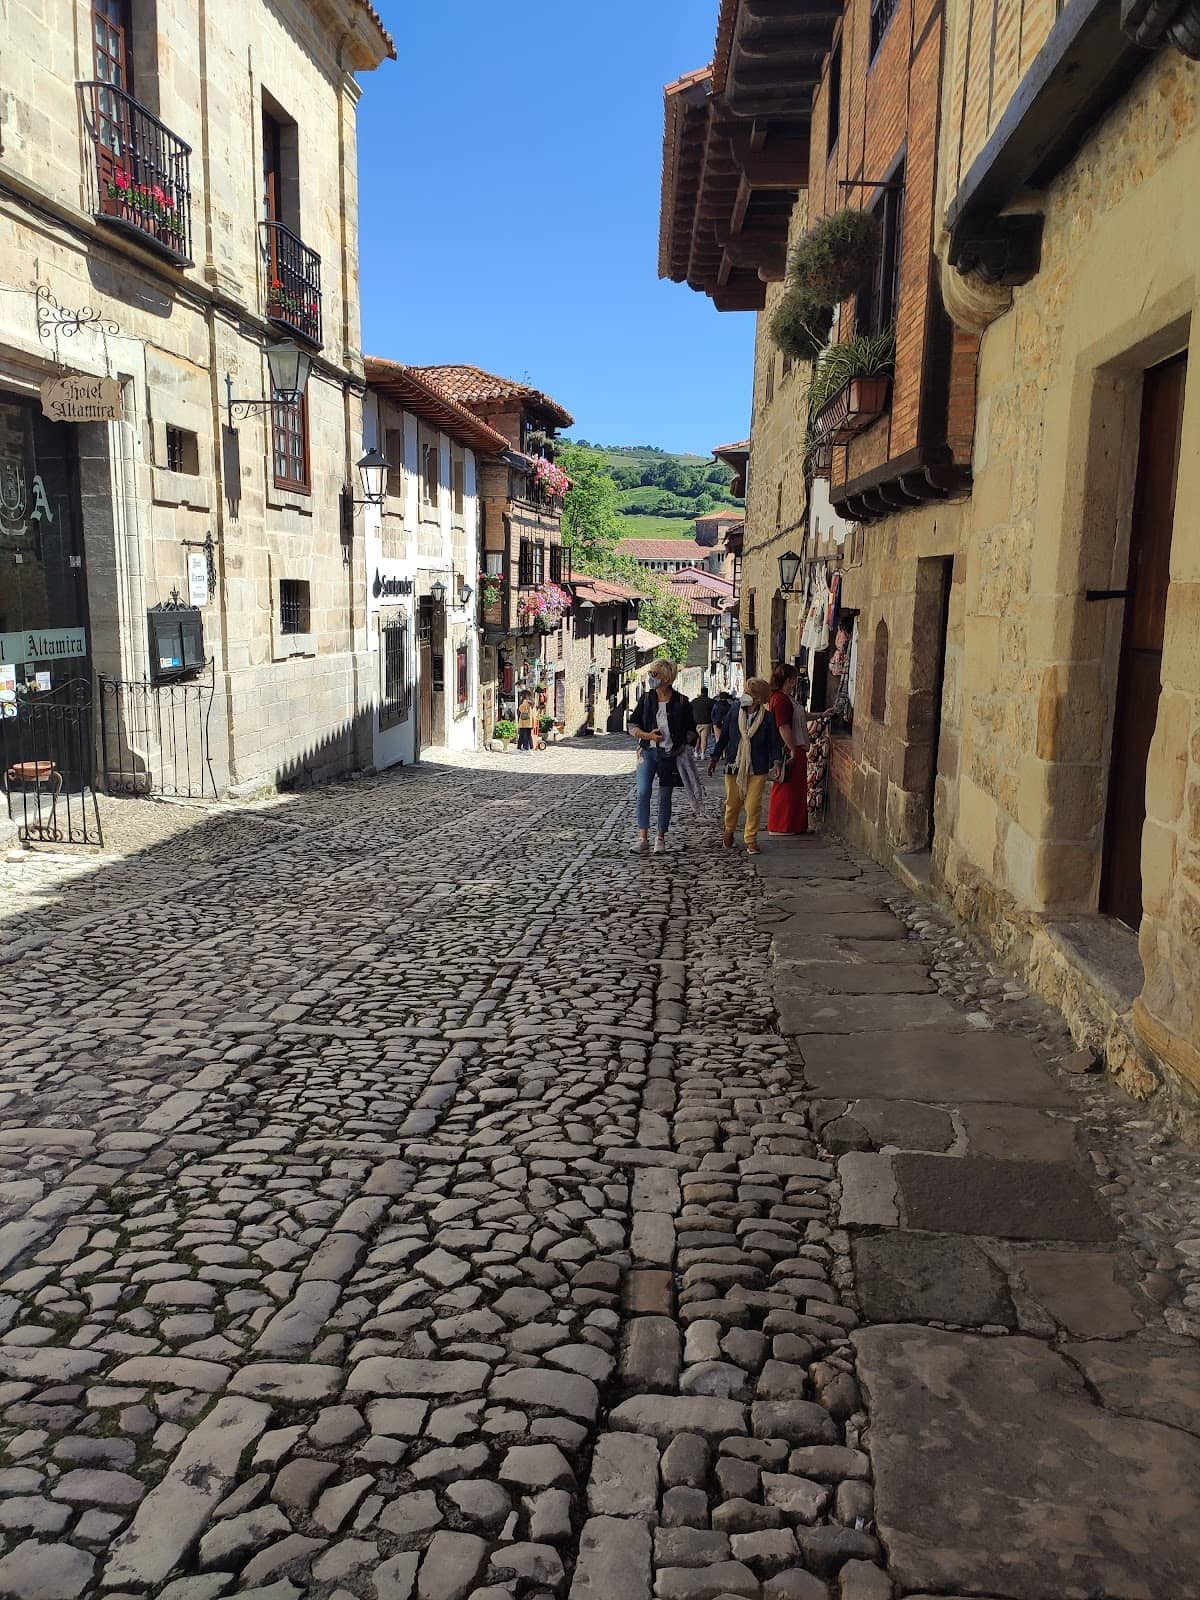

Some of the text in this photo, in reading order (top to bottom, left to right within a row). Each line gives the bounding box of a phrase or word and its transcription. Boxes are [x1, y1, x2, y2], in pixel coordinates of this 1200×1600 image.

[60, 381, 102, 400] Hotel
[51, 401, 115, 418] Altamira
[31, 474, 54, 522] A
[381, 574, 413, 595] Santander
[27, 634, 83, 656] Altamira
